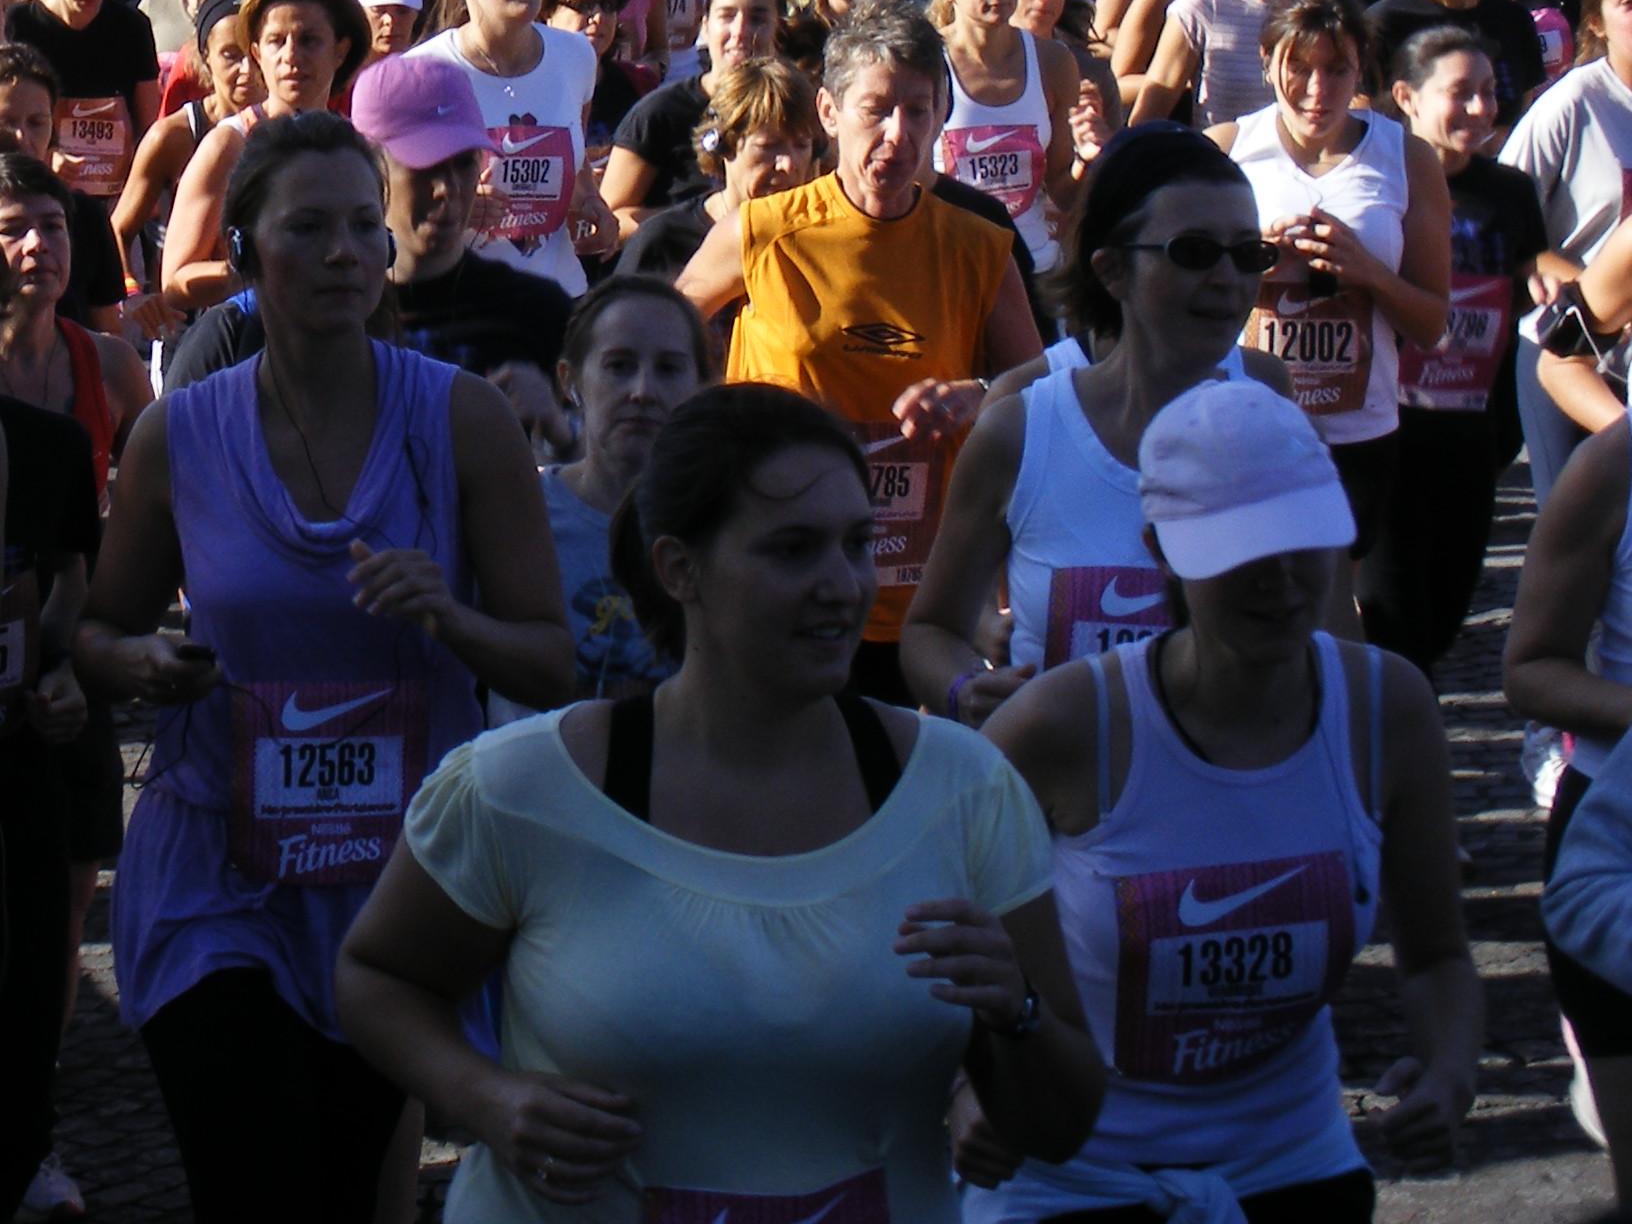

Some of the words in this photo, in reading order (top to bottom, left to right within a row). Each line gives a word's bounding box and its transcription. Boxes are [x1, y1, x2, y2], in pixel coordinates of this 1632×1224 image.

[71, 119, 114, 141] 13493
[502, 158, 551, 184] 15302
[969, 153, 1019, 180] 15323
[1263, 320, 1353, 363] 12002
[1297, 386, 1342, 407] ness
[871, 464, 911, 497] 785
[279, 742, 377, 788] 12563
[276, 832, 383, 879] Fitness
[1177, 931, 1294, 988] 13328
[1172, 1023, 1293, 1076] Fitness
